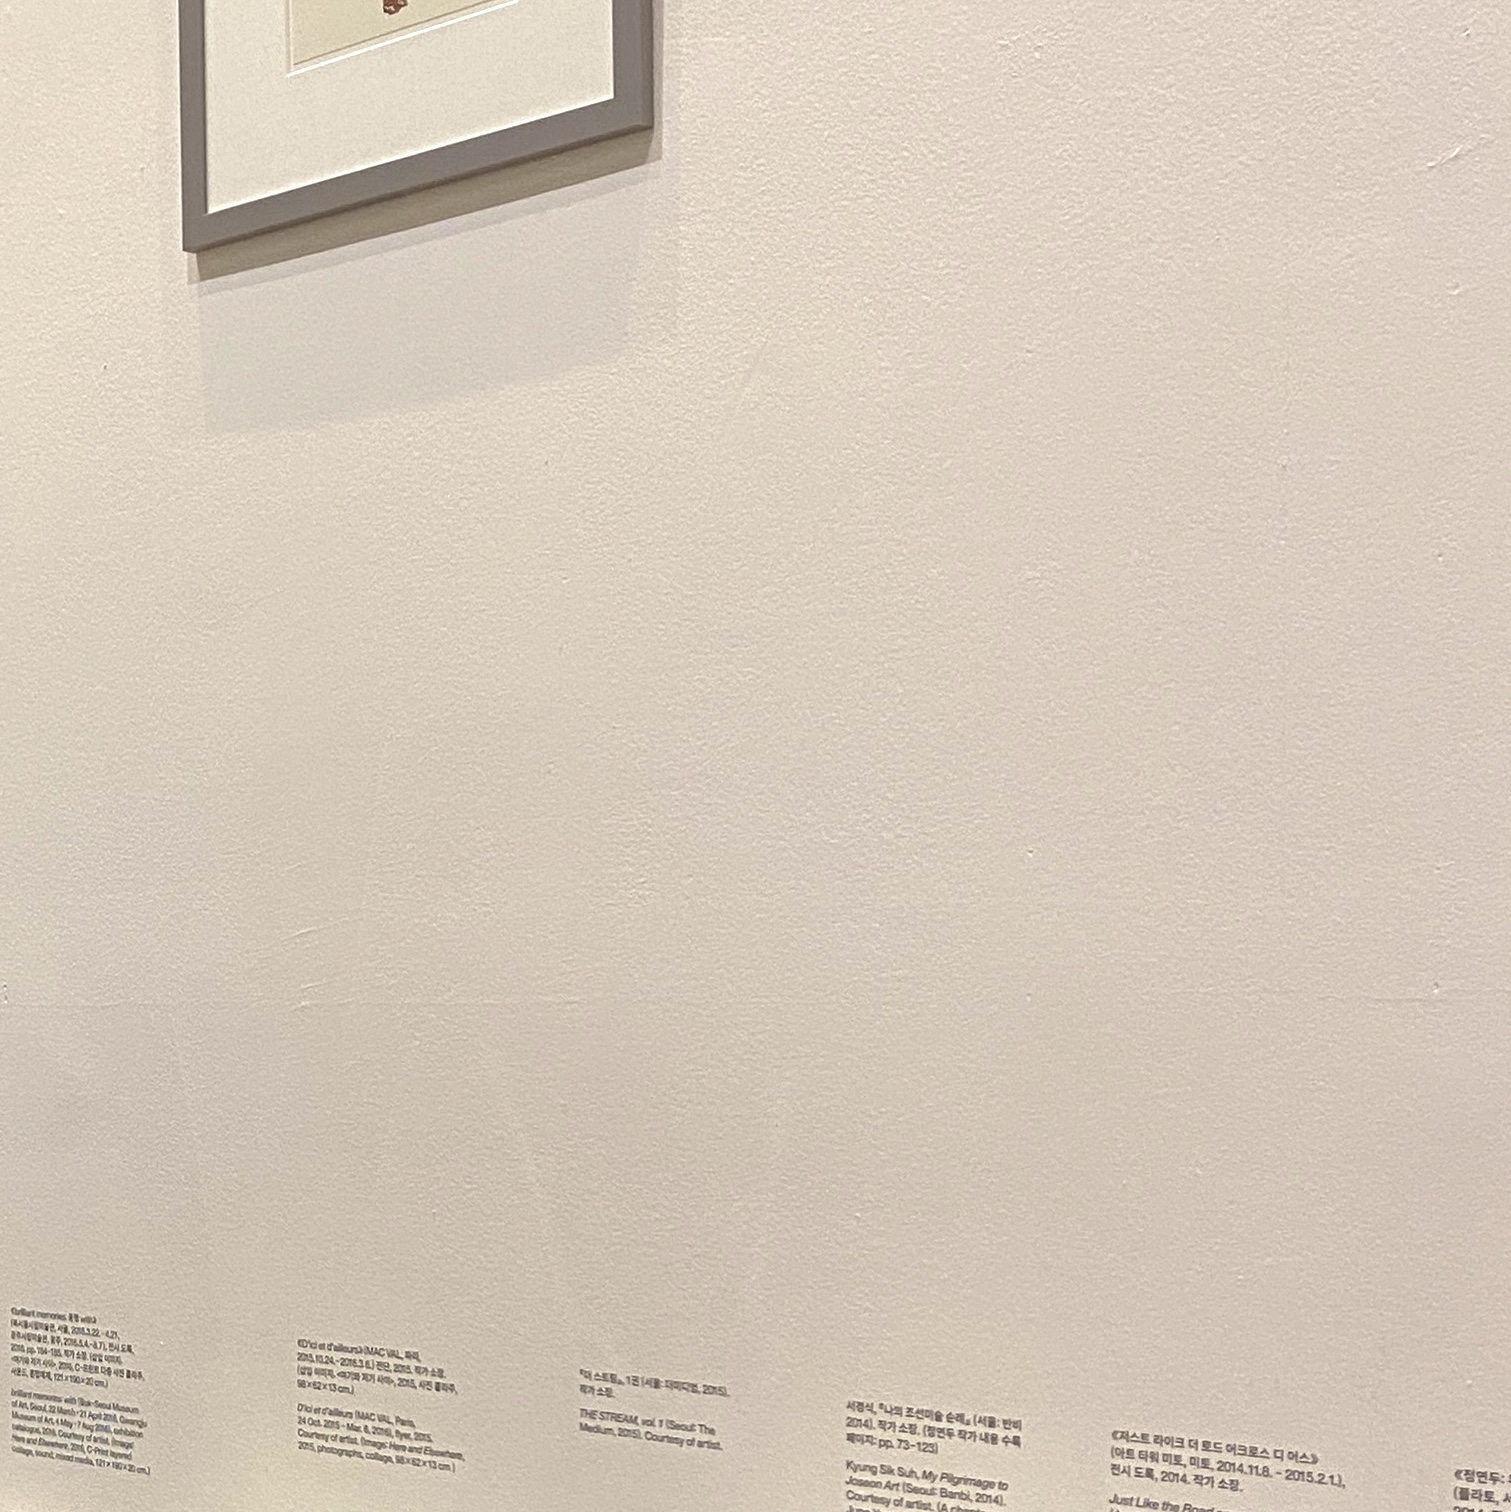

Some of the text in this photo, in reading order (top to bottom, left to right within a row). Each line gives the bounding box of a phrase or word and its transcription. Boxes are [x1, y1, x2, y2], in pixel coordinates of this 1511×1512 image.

[845, 1460, 877, 1476] Kyung
[921, 1470, 938, 1483] My
[997, 1481, 1008, 1491] to
[893, 1497, 904, 1507] of
[1108, 1493, 1133, 1506] Just
[1135, 1497, 1159, 1510] Like
[1161, 1501, 1180, 1512] the
